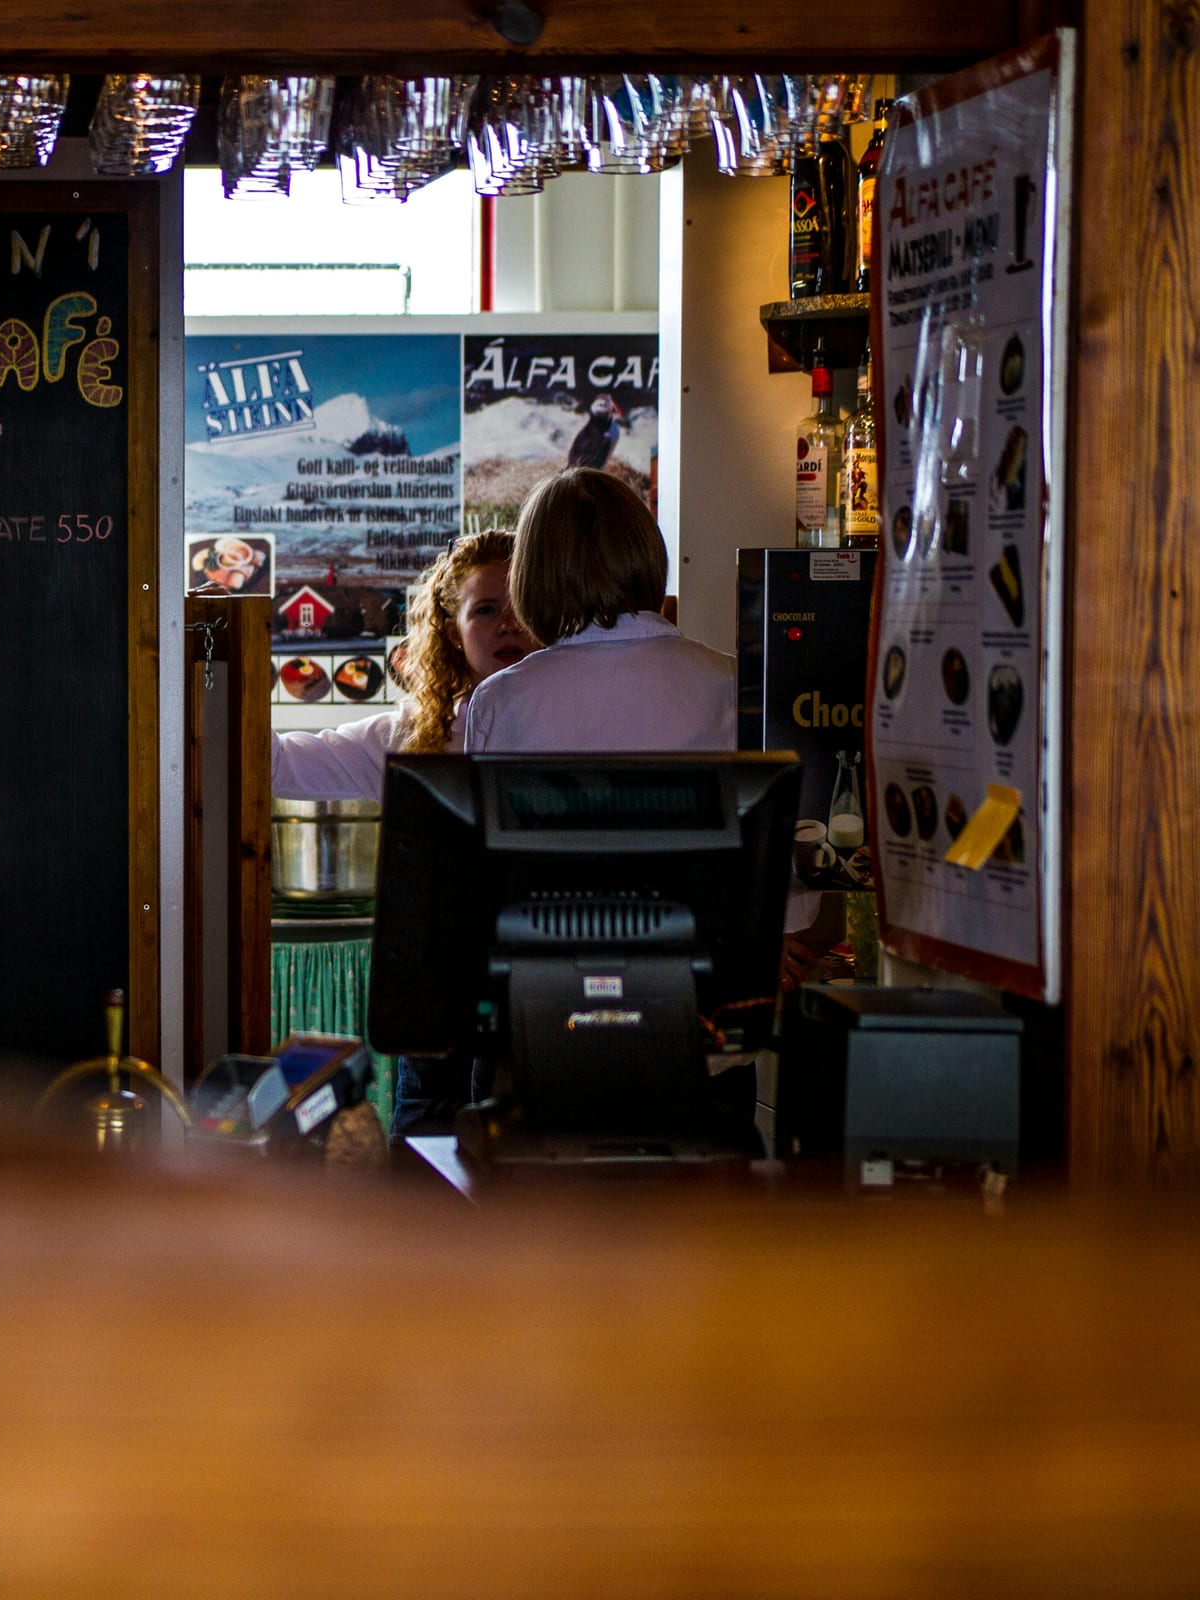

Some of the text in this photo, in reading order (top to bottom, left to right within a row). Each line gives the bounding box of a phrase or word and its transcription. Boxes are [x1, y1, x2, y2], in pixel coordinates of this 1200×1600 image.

[466, 337, 659, 391] ÁLFA CAF
[856, 453, 878, 464] Morga
[56, 514, 115, 543] 550
[772, 612, 816, 621] CHOCOLATE
[792, 690, 864, 728] Choc
